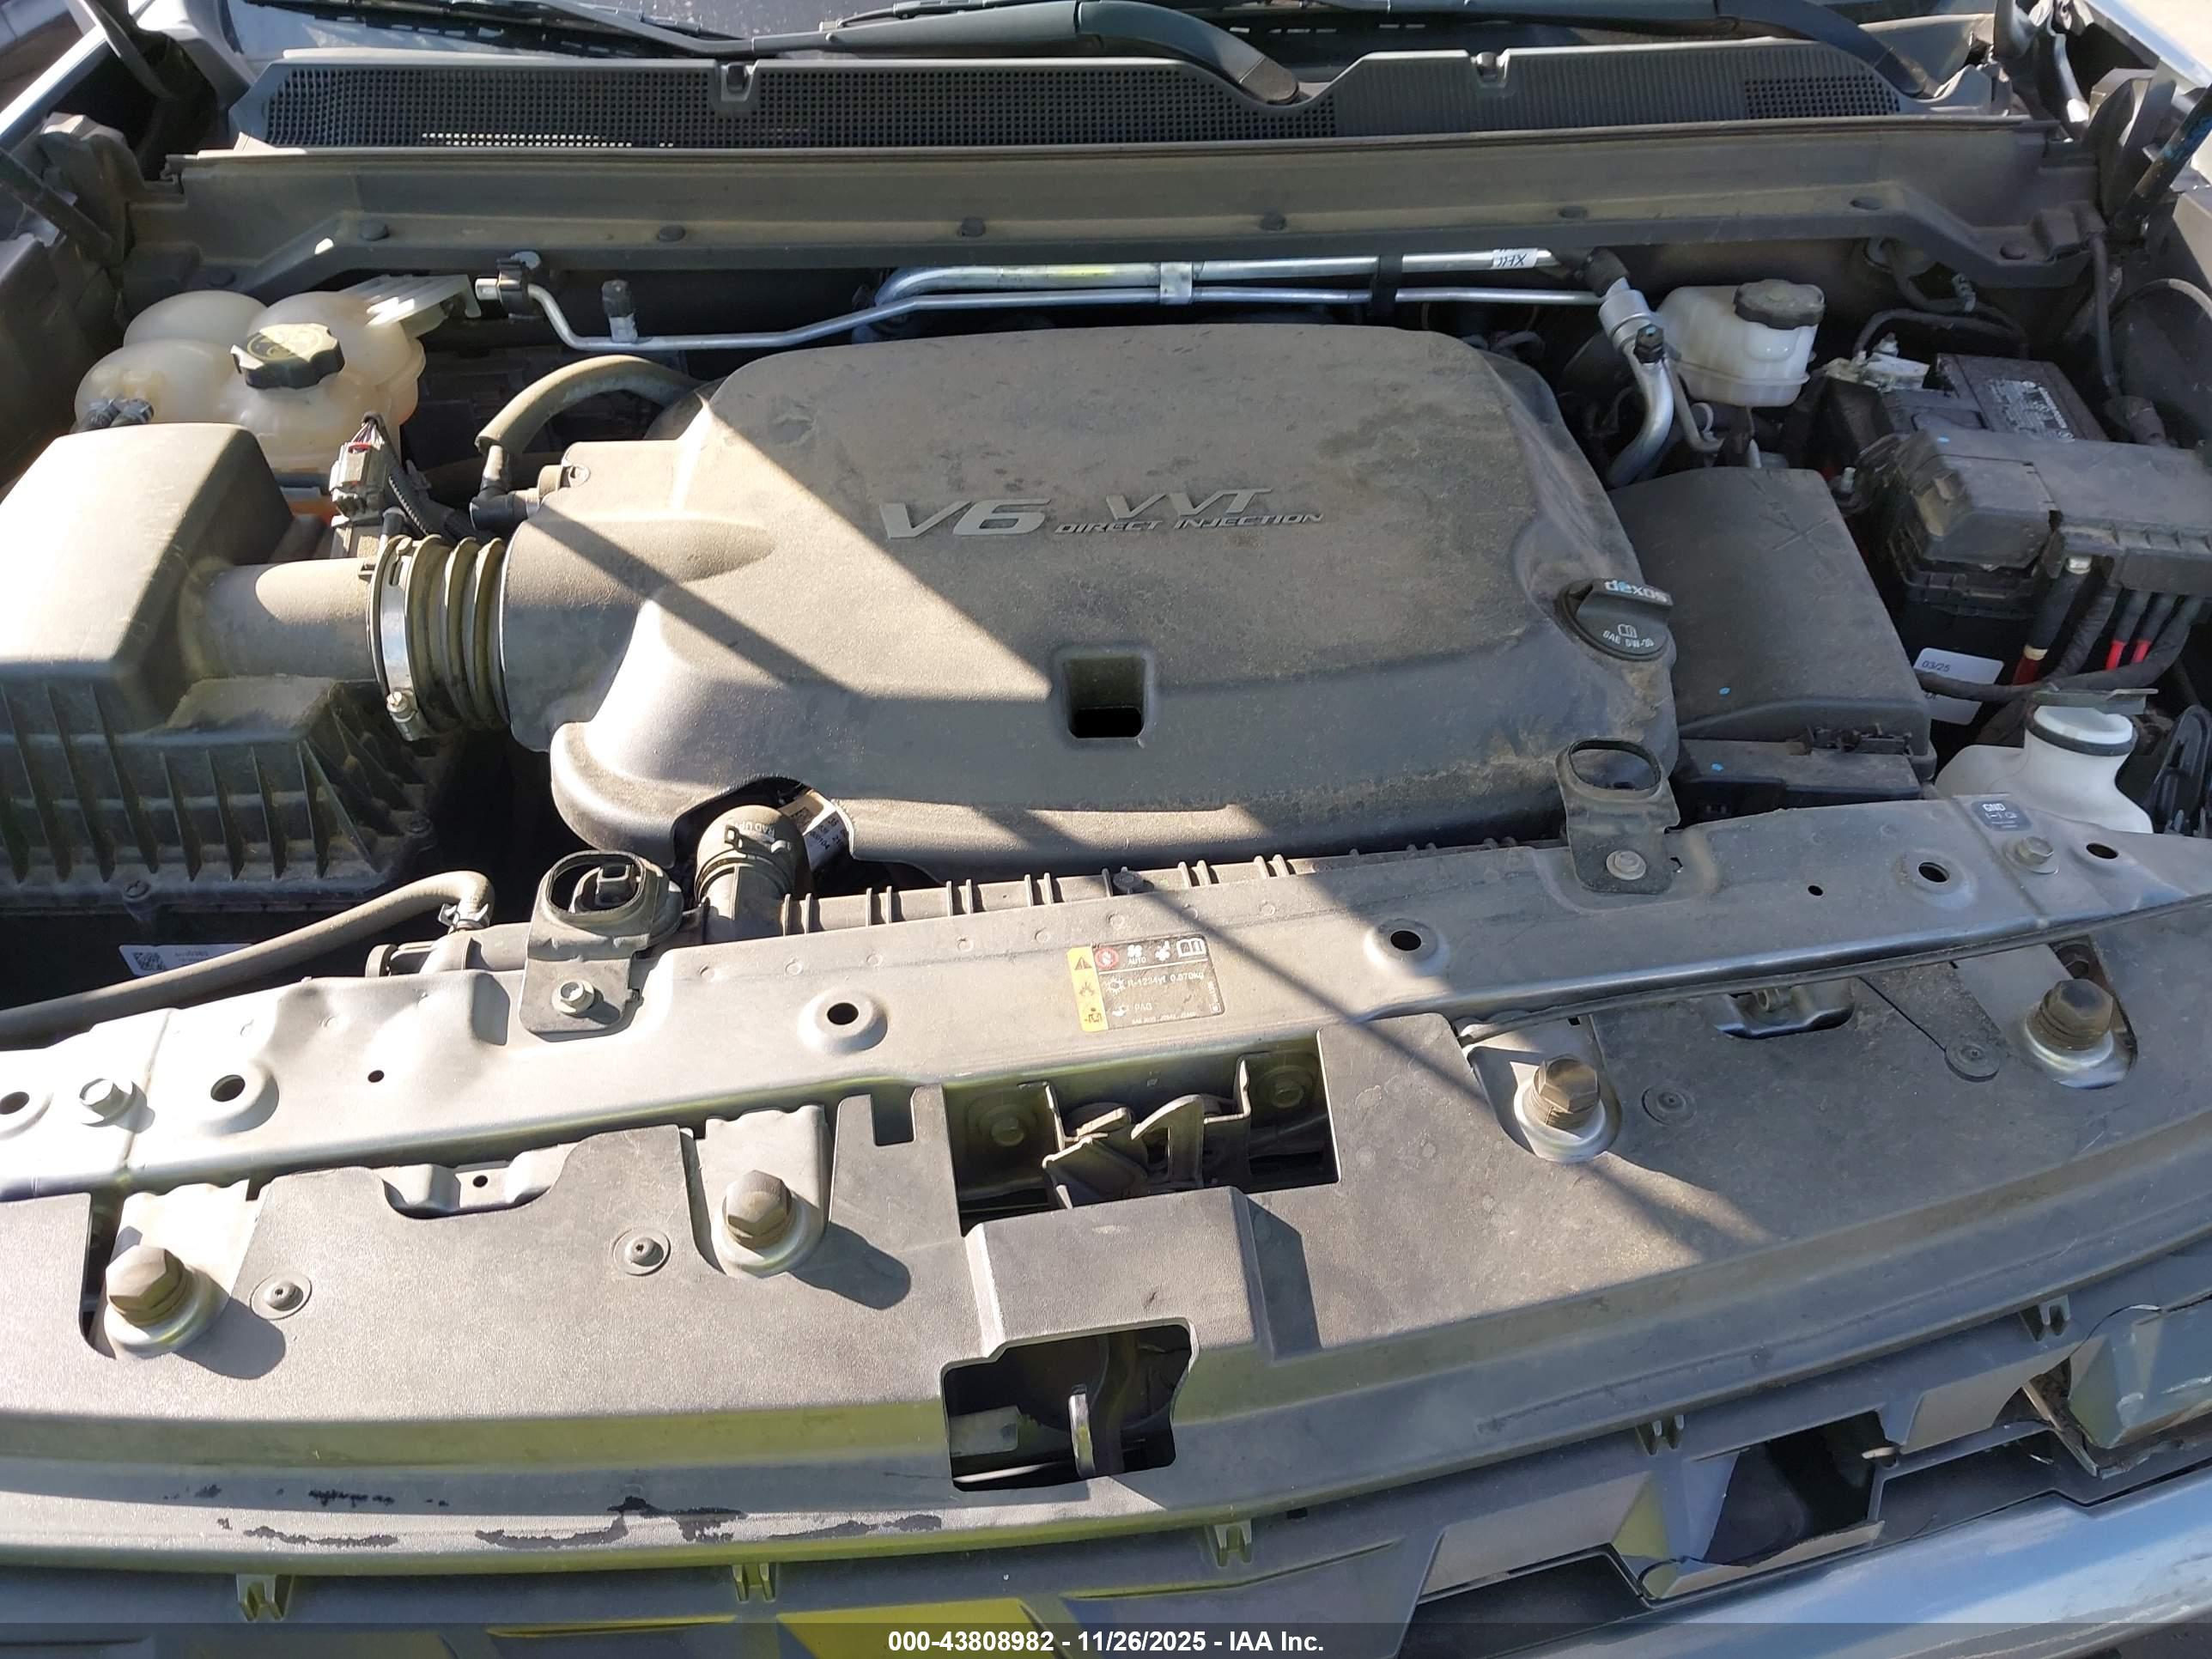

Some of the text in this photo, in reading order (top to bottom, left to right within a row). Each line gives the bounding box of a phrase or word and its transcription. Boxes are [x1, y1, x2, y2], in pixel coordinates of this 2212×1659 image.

[879, 488, 1273, 539] V6 VVT
[1054, 514, 1325, 534] DIRECT INJECTION
[1604, 580, 1668, 603] dexos
[1602, 630, 1621, 645] SAE
[1922, 659, 1951, 673] 03/25
[1982, 803, 2006, 812] GND
[755, 823, 775, 837] RAD
[1127, 957, 1147, 965] AUTO
